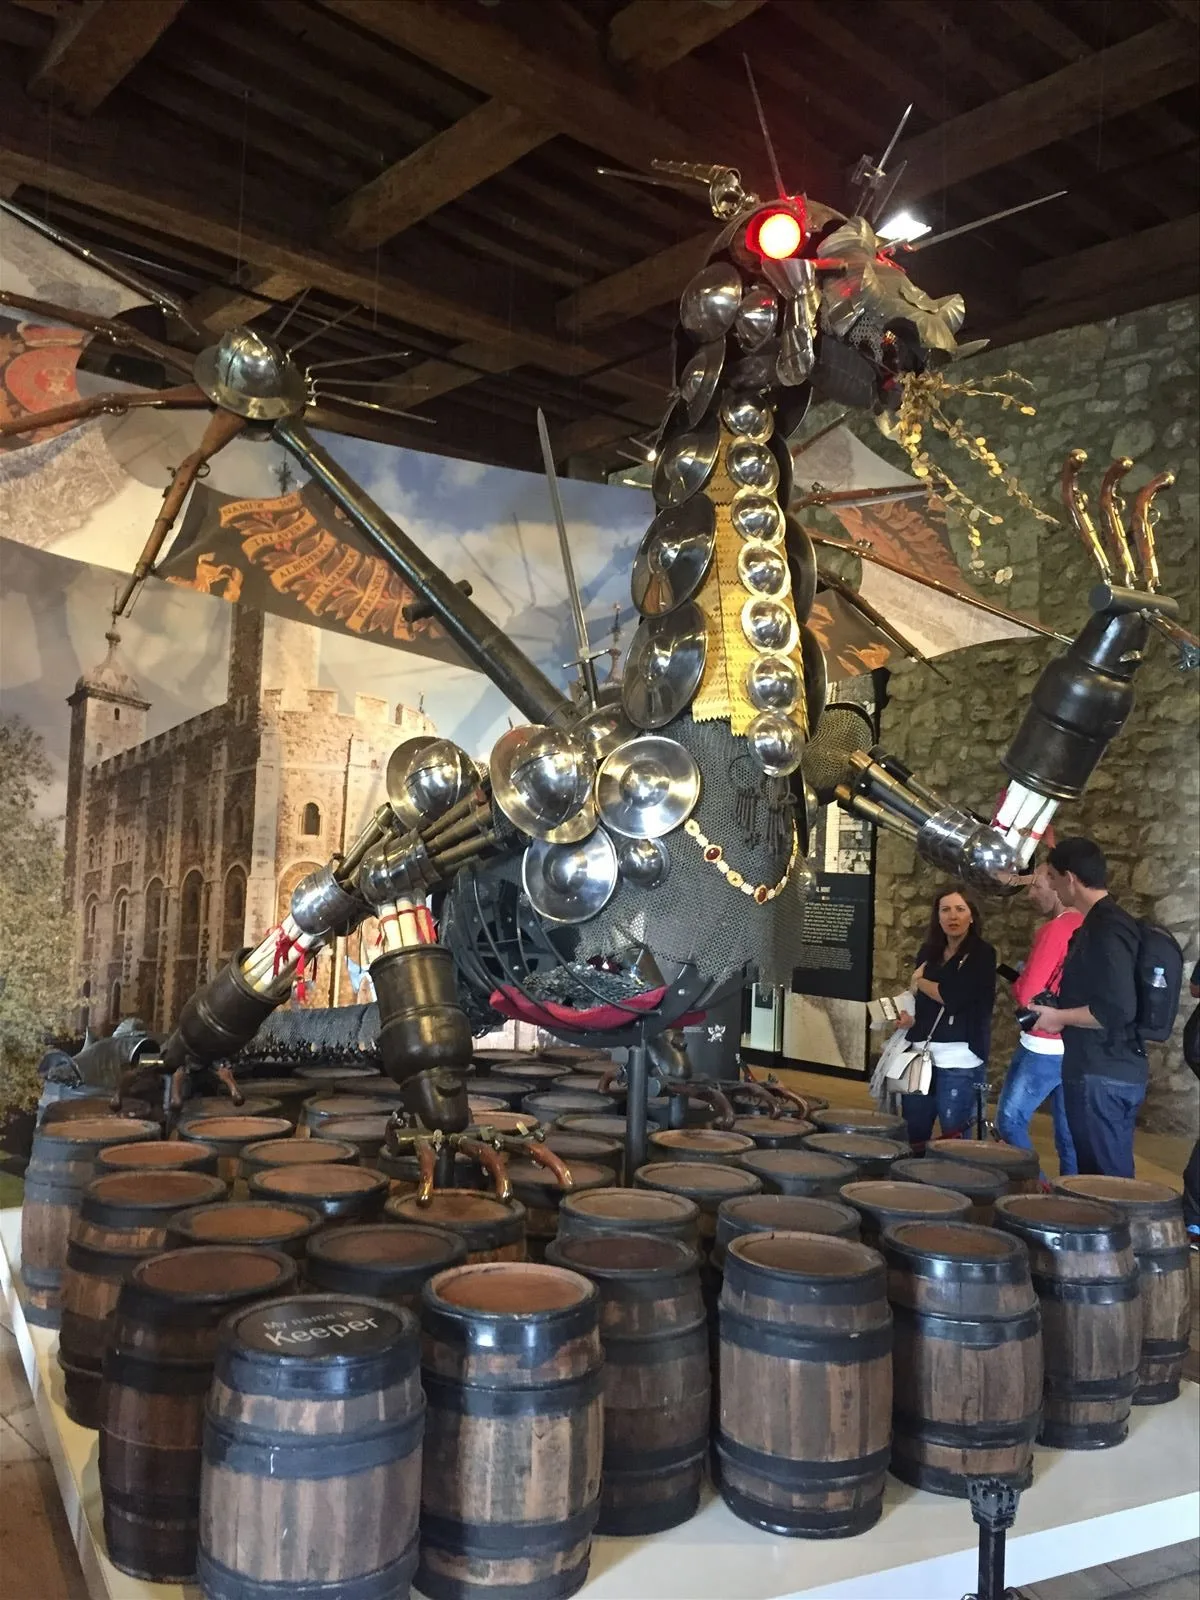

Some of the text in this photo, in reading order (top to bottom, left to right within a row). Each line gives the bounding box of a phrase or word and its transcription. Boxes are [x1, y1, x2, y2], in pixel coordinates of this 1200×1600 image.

[222, 502, 264, 516] NAMUR
[253, 519, 309, 547] TALAVERA
[279, 541, 330, 580] ALBUHERA
[309, 548, 357, 605] SALAMANCA
[355, 564, 387, 618] PYRENEES
[263, 1321, 287, 1330] My
[264, 1317, 379, 1347] Keeper
